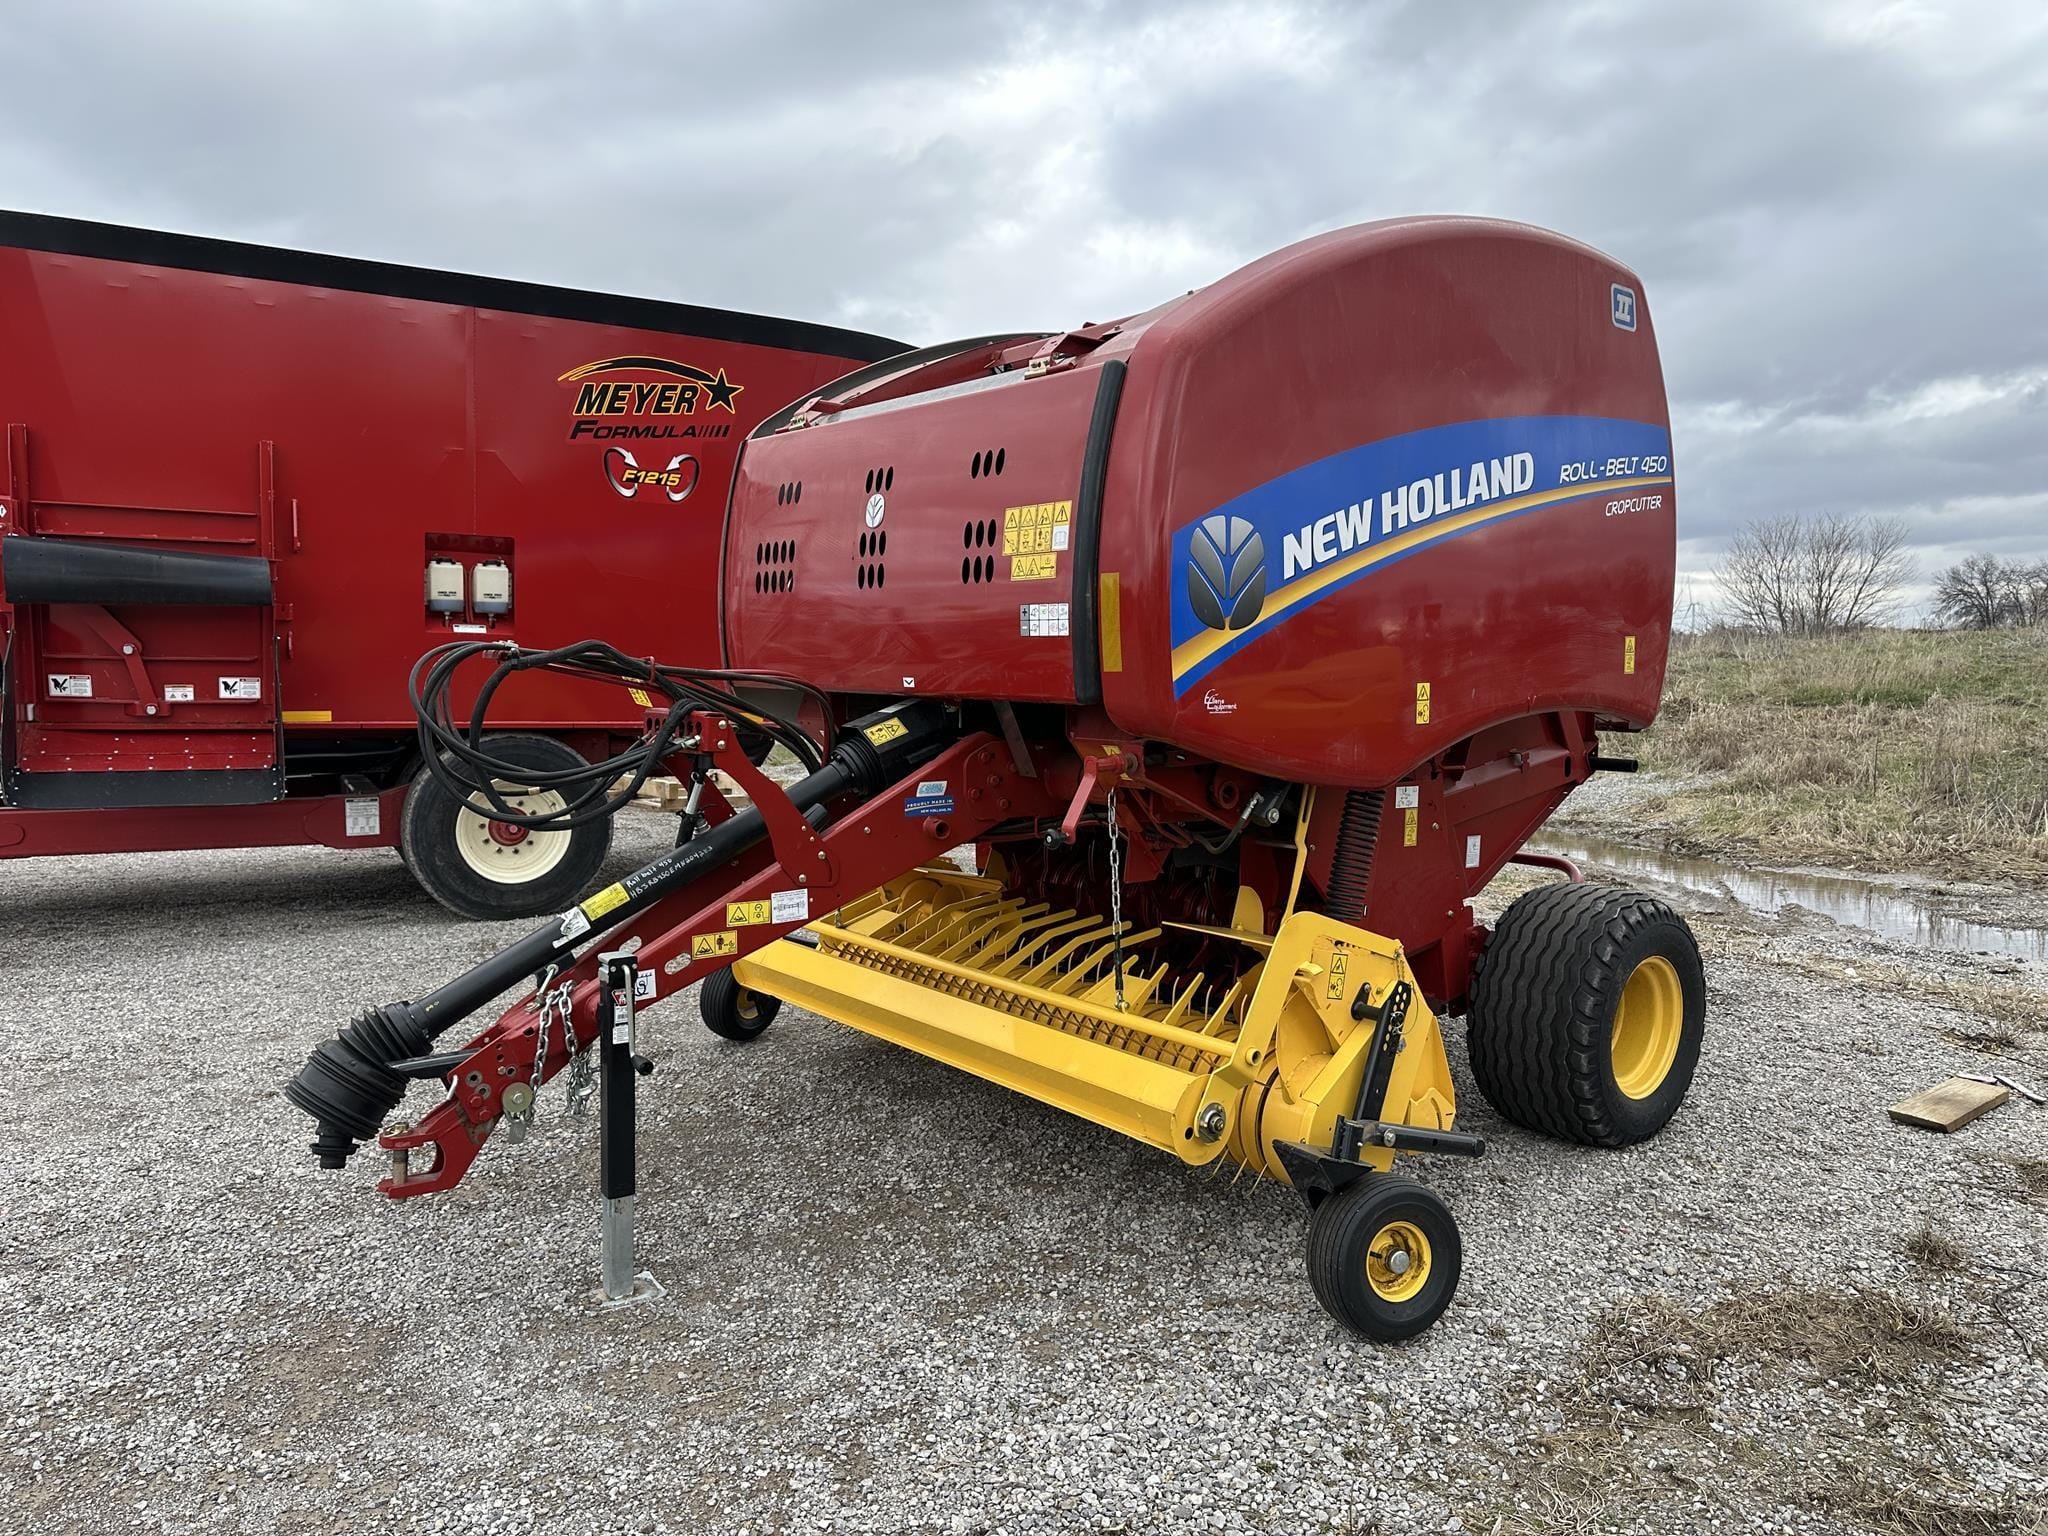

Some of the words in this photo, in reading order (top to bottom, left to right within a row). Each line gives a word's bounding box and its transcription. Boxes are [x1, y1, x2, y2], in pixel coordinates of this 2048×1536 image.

[573, 382, 701, 415] MEYER
[1641, 455, 1667, 473] 450
[622, 469, 682, 486] F1215
[1605, 495, 1662, 516] CROPCUTTER
[1283, 498, 1373, 580] NEW
[1381, 452, 1535, 535] HOLLAND
[658, 858, 672, 867] 450
